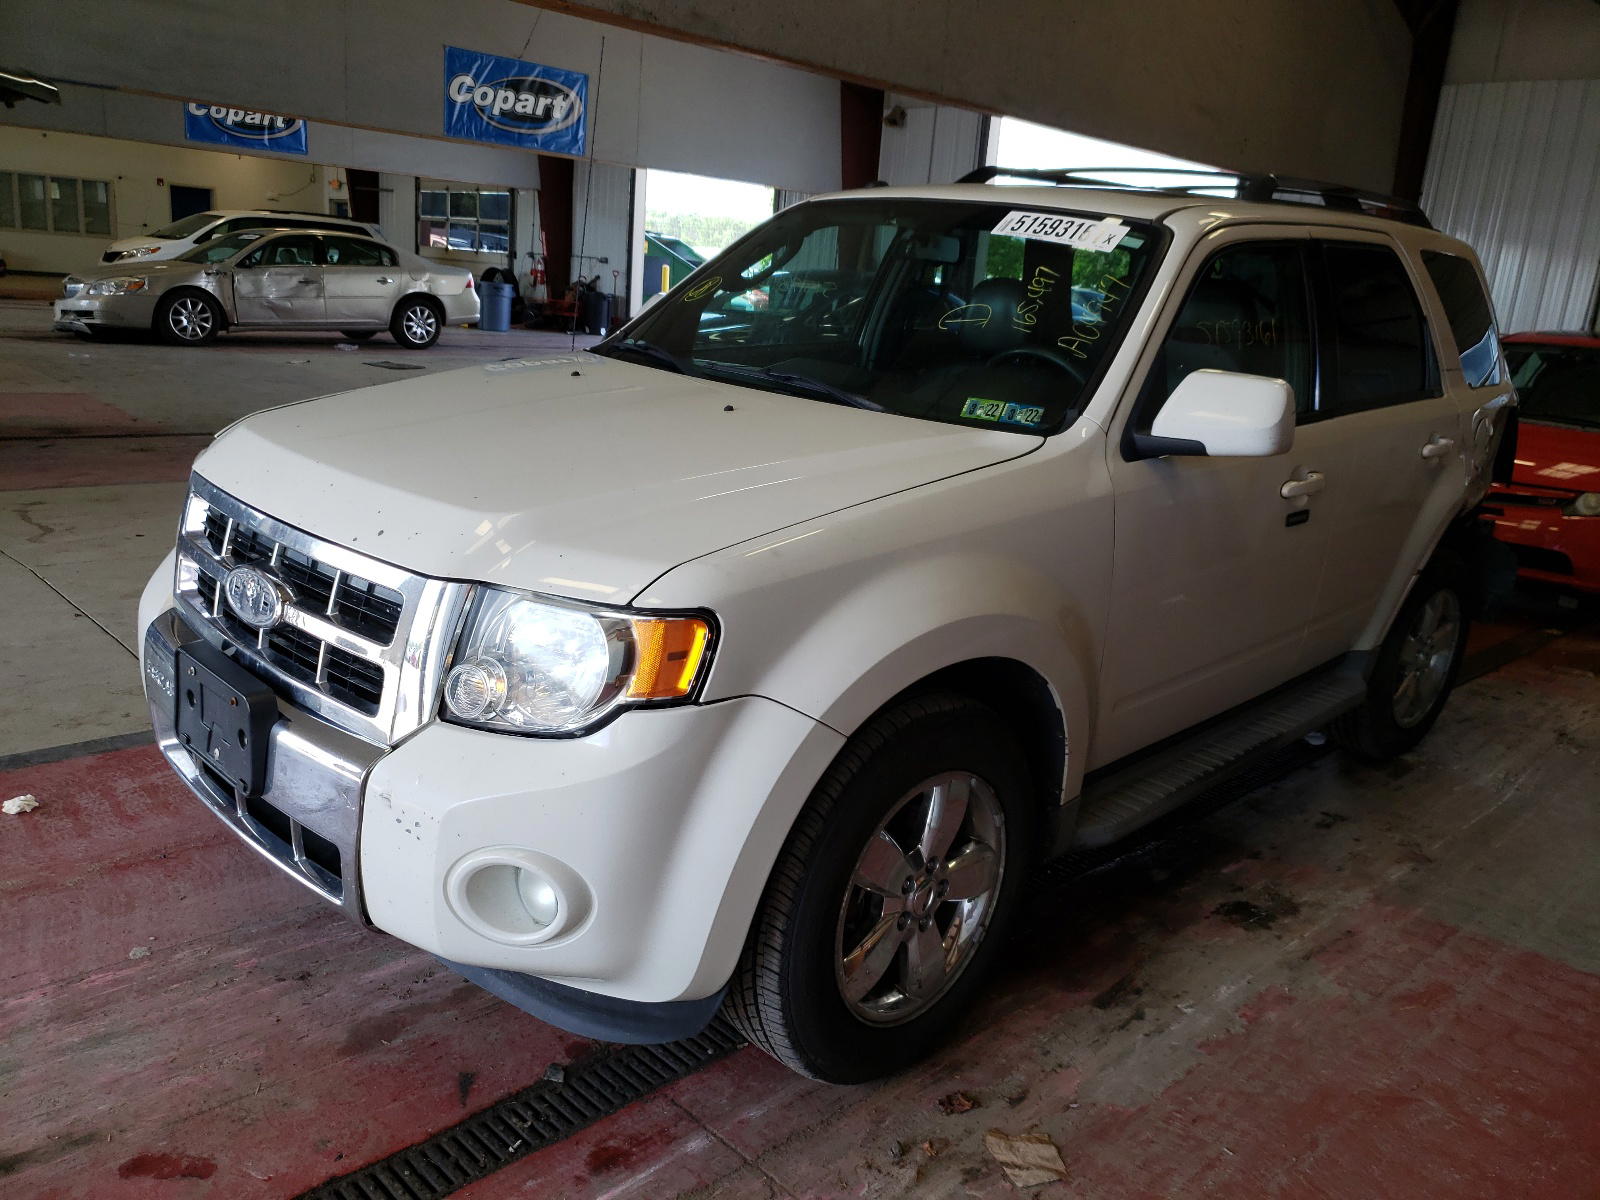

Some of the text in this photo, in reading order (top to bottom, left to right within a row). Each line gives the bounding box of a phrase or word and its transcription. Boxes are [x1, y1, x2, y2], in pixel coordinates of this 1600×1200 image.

[449, 74, 569, 119] Copart
[189, 102, 285, 128] Copart
[1011, 215, 1104, 244] 5159316
